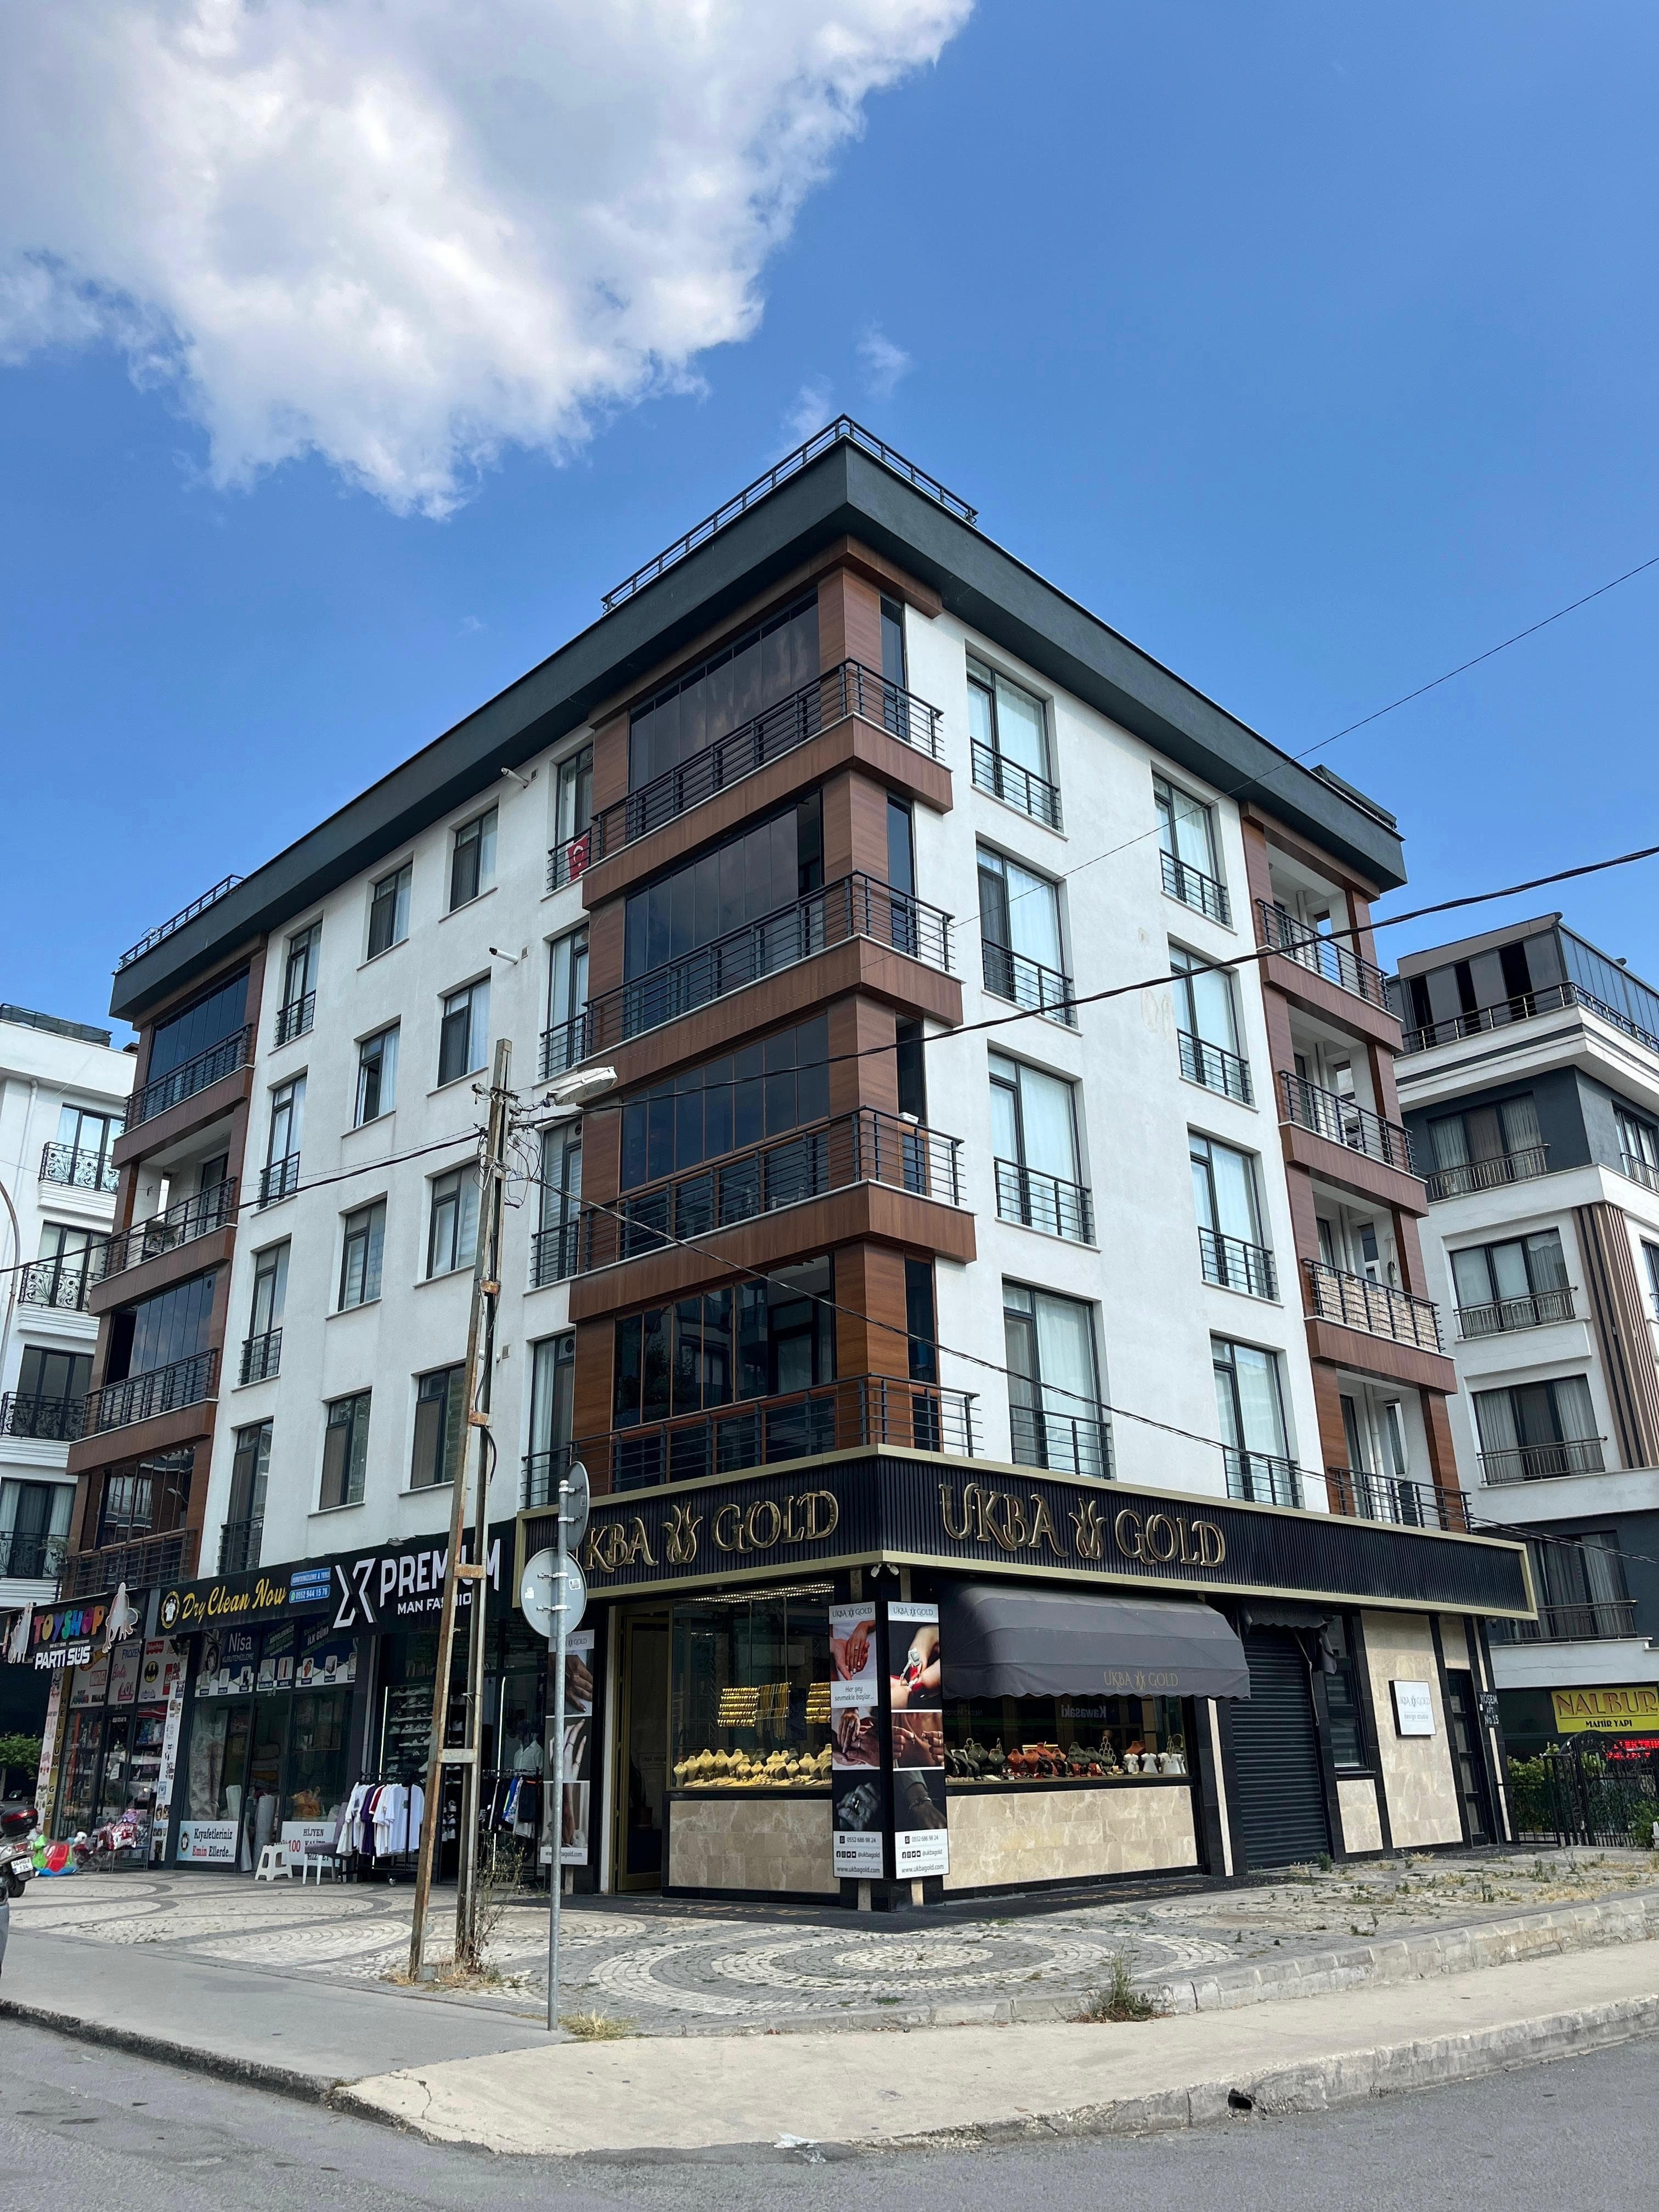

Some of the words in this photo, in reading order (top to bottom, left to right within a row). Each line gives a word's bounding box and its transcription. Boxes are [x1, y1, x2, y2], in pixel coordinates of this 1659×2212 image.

[575, 1517, 659, 1573] KBA
[713, 1491, 839, 1554] GOLD
[939, 1483, 1069, 1557] UKBA
[1115, 1509, 1226, 1567] GOLD
[380, 1538, 500, 1608] PREMUM
[182, 1593, 206, 1624] Dry
[207, 1585, 250, 1616] Clean
[252, 1578, 286, 1609] Now
[316, 1588, 321, 1596] 15
[398, 1600, 424, 1615] MAN
[893, 1606, 910, 1616] UKBA
[917, 1608, 933, 1616] GOLD
[34, 1606, 104, 1644] TOYSHOP
[228, 1633, 252, 1652] Nisa
[66, 1646, 91, 1666] SÜS
[1104, 1669, 1135, 1689] UKBA
[1148, 1672, 1178, 1689] GOLD
[1556, 1691, 1658, 1716] NALBUR
[51, 1698, 66, 1768] HELYUM
[1585, 1719, 1612, 1728] MAHİR
[194, 1828, 233, 1842] Kıyafetleriniz
[303, 1826, 324, 1836] HİJYEN
[192, 1845, 207, 1857] Emin
[837, 1866, 880, 1874] www.ukbagold.com
[901, 1864, 944, 1872] www.ukbagold.com
